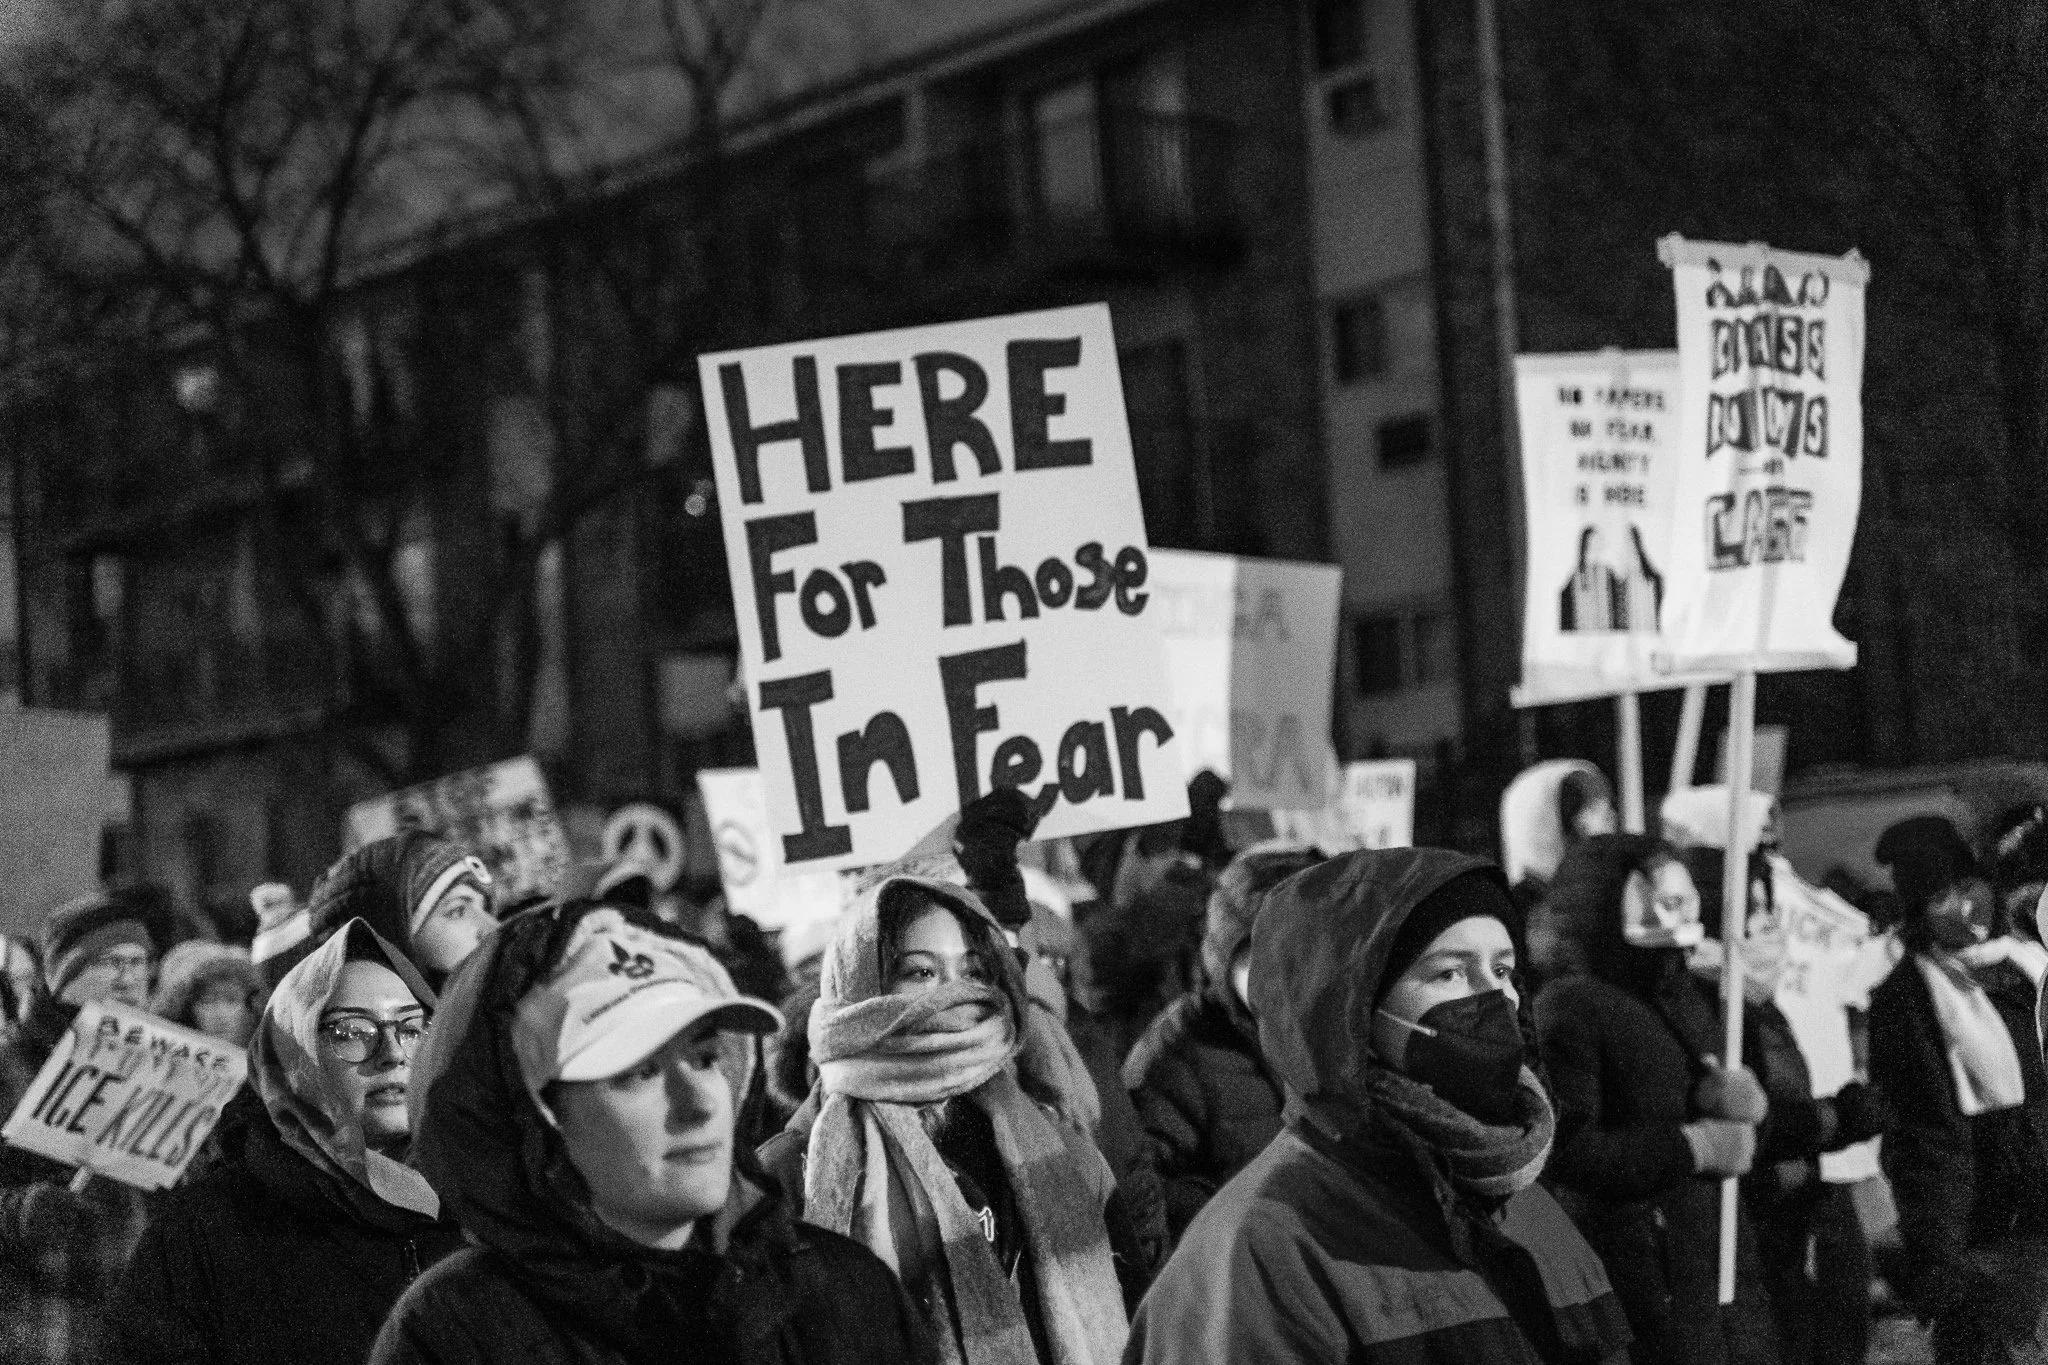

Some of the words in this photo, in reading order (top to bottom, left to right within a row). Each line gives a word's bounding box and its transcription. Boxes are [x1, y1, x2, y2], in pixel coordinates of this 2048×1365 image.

[718, 336, 1093, 505] HERE
[745, 510, 887, 663] For
[901, 492, 1150, 629] Those
[759, 669, 921, 864] In
[939, 638, 1175, 812] Fear
[32, 1060, 125, 1135] ICE
[96, 1084, 217, 1168] KILLS
